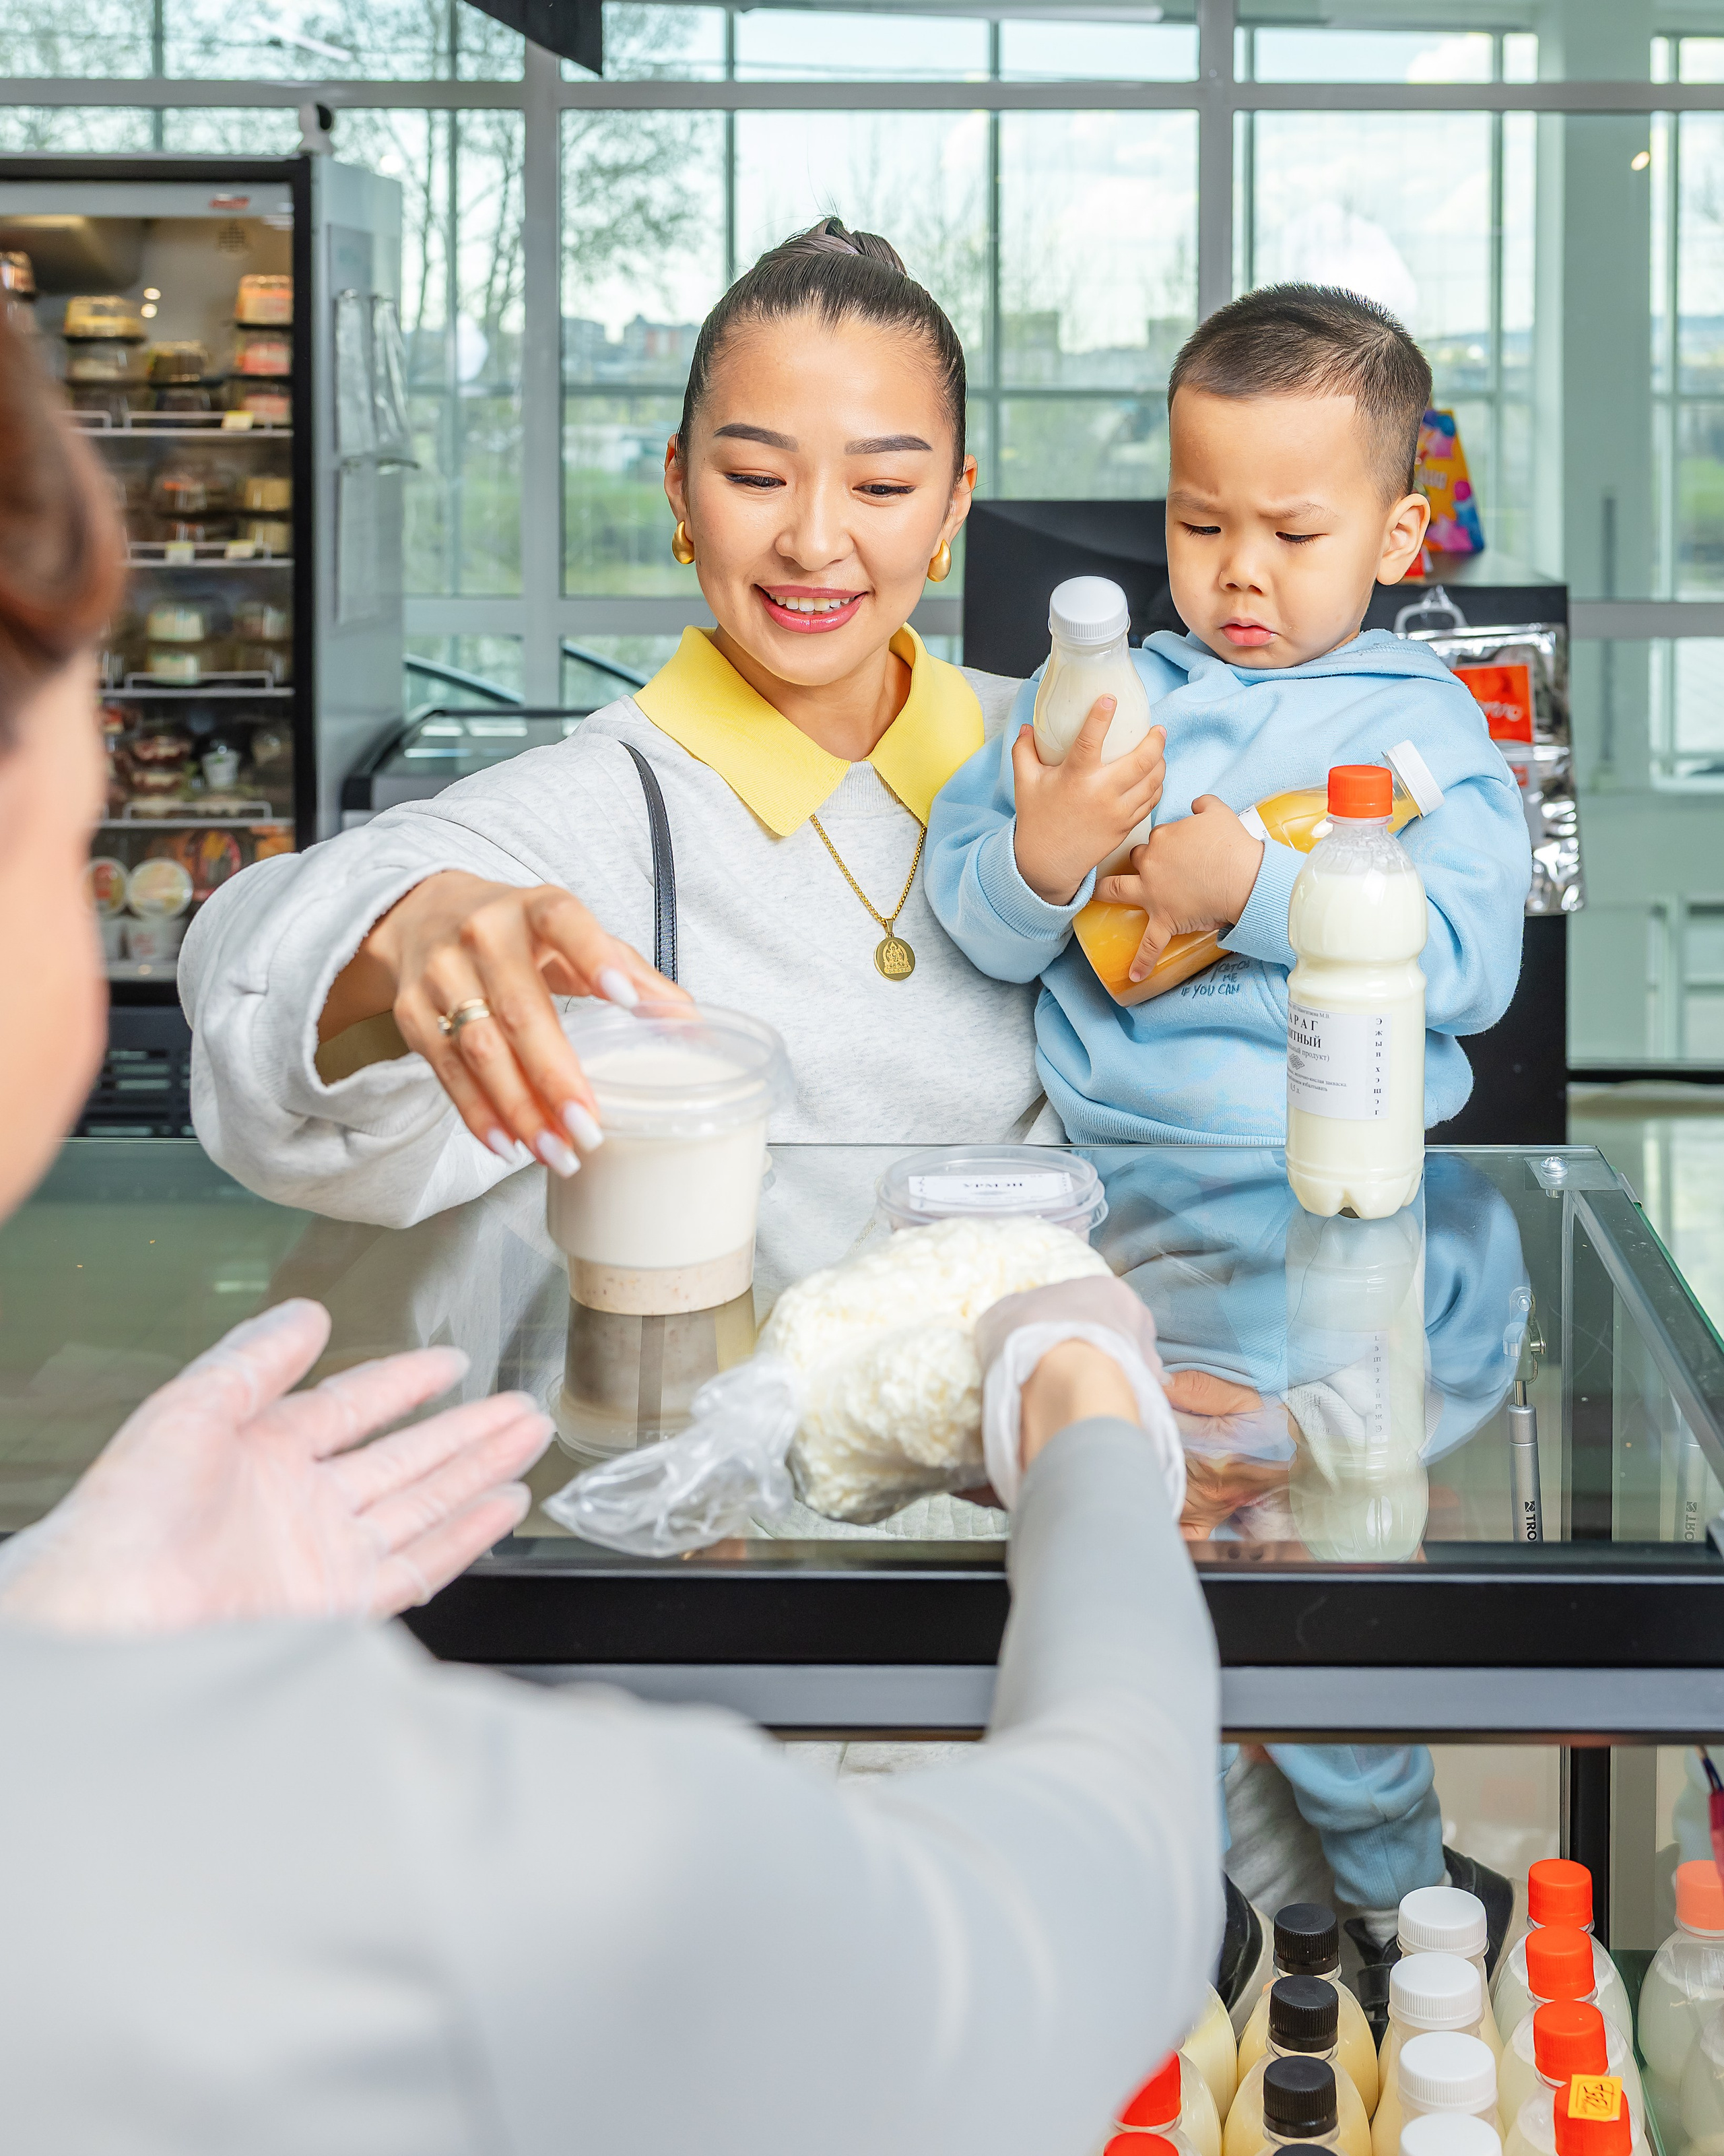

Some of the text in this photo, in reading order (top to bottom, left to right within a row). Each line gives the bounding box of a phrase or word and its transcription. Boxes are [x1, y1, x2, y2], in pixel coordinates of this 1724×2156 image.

[1218, 960, 1251, 973] CATCH
[1222, 973, 1238, 983] ME
[1181, 983, 1240, 999] IF YOU CAN
[1302, 1049, 1330, 1062] продукт)
